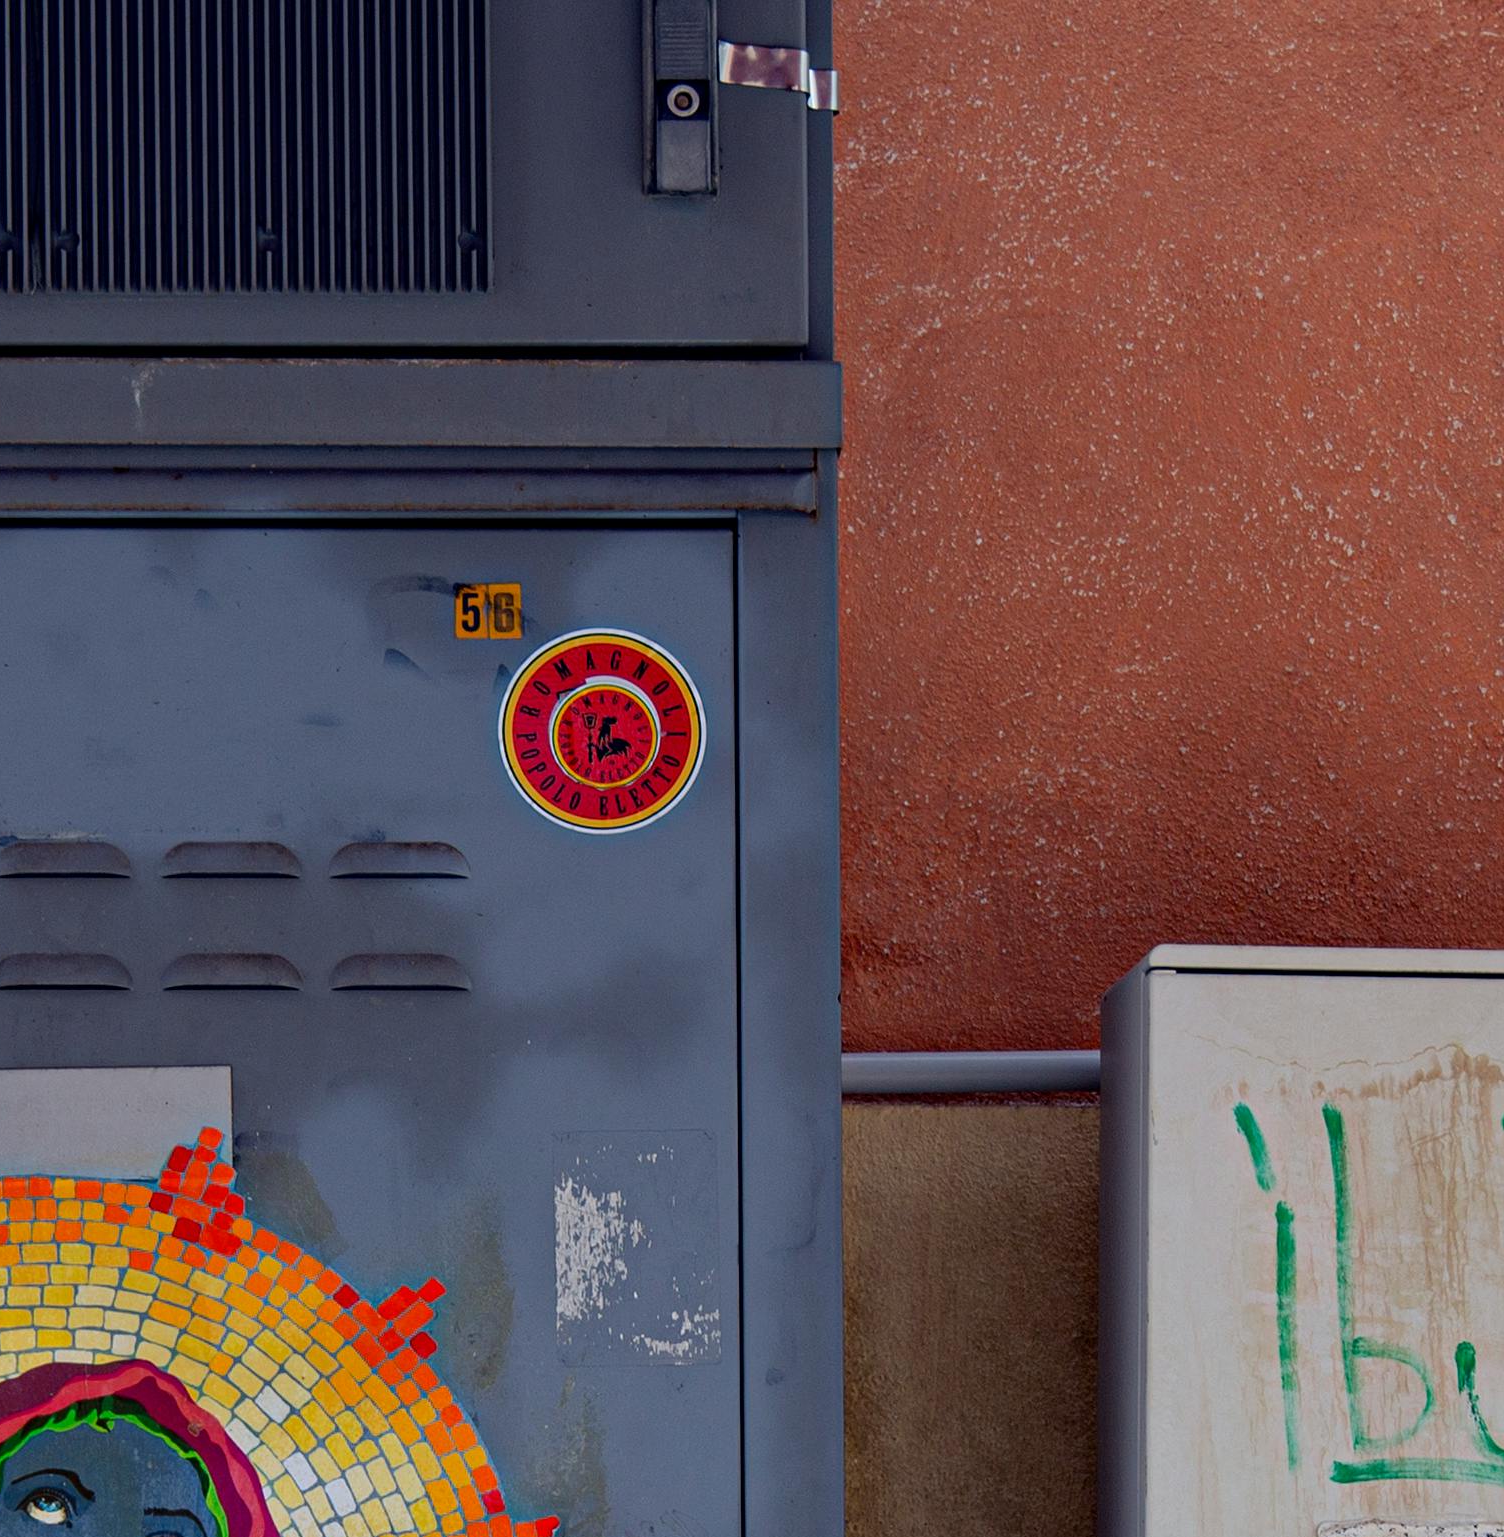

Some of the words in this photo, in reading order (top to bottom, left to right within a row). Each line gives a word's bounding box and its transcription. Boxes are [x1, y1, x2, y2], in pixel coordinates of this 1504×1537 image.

[460, 592, 516, 633] 56
[519, 649, 688, 737] ROMAGNOLI
[516, 731, 582, 811] POPOLO
[598, 753, 682, 817] ELETTO
